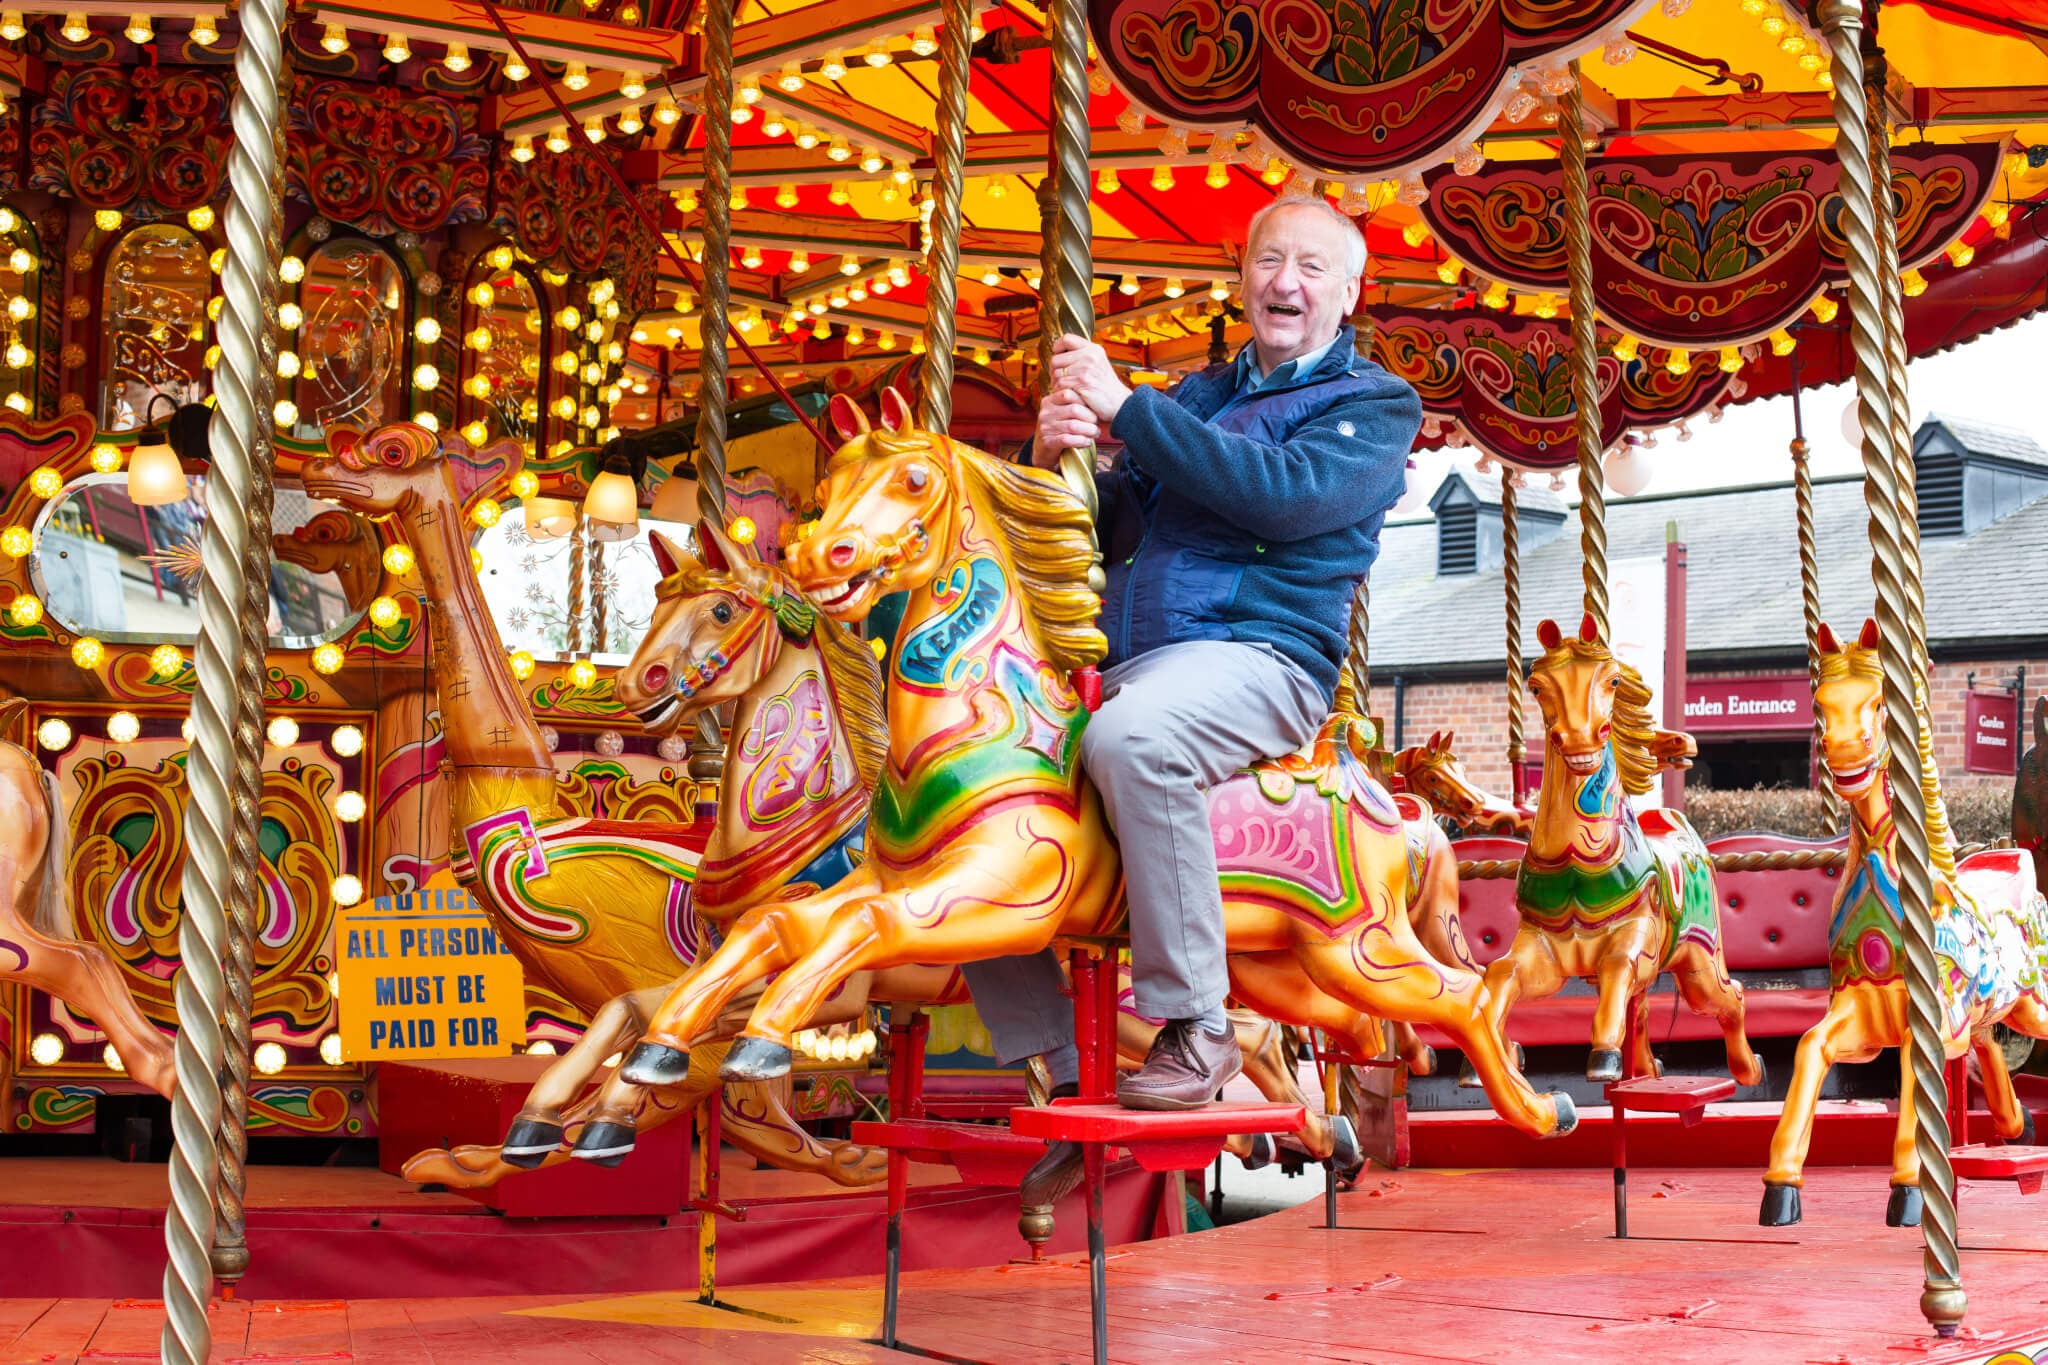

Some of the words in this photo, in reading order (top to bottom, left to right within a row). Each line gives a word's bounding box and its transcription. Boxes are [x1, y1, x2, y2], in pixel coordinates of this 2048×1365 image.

[905, 579, 1001, 674] KEATON
[1728, 695, 1797, 715] Entrance
[763, 701, 829, 800] TYRA
[347, 929, 388, 958] ALL
[375, 976, 445, 1006] MUST
[458, 974, 485, 1003] BE
[370, 1019, 435, 1049] PAID
[448, 1017, 498, 1046] FOR
